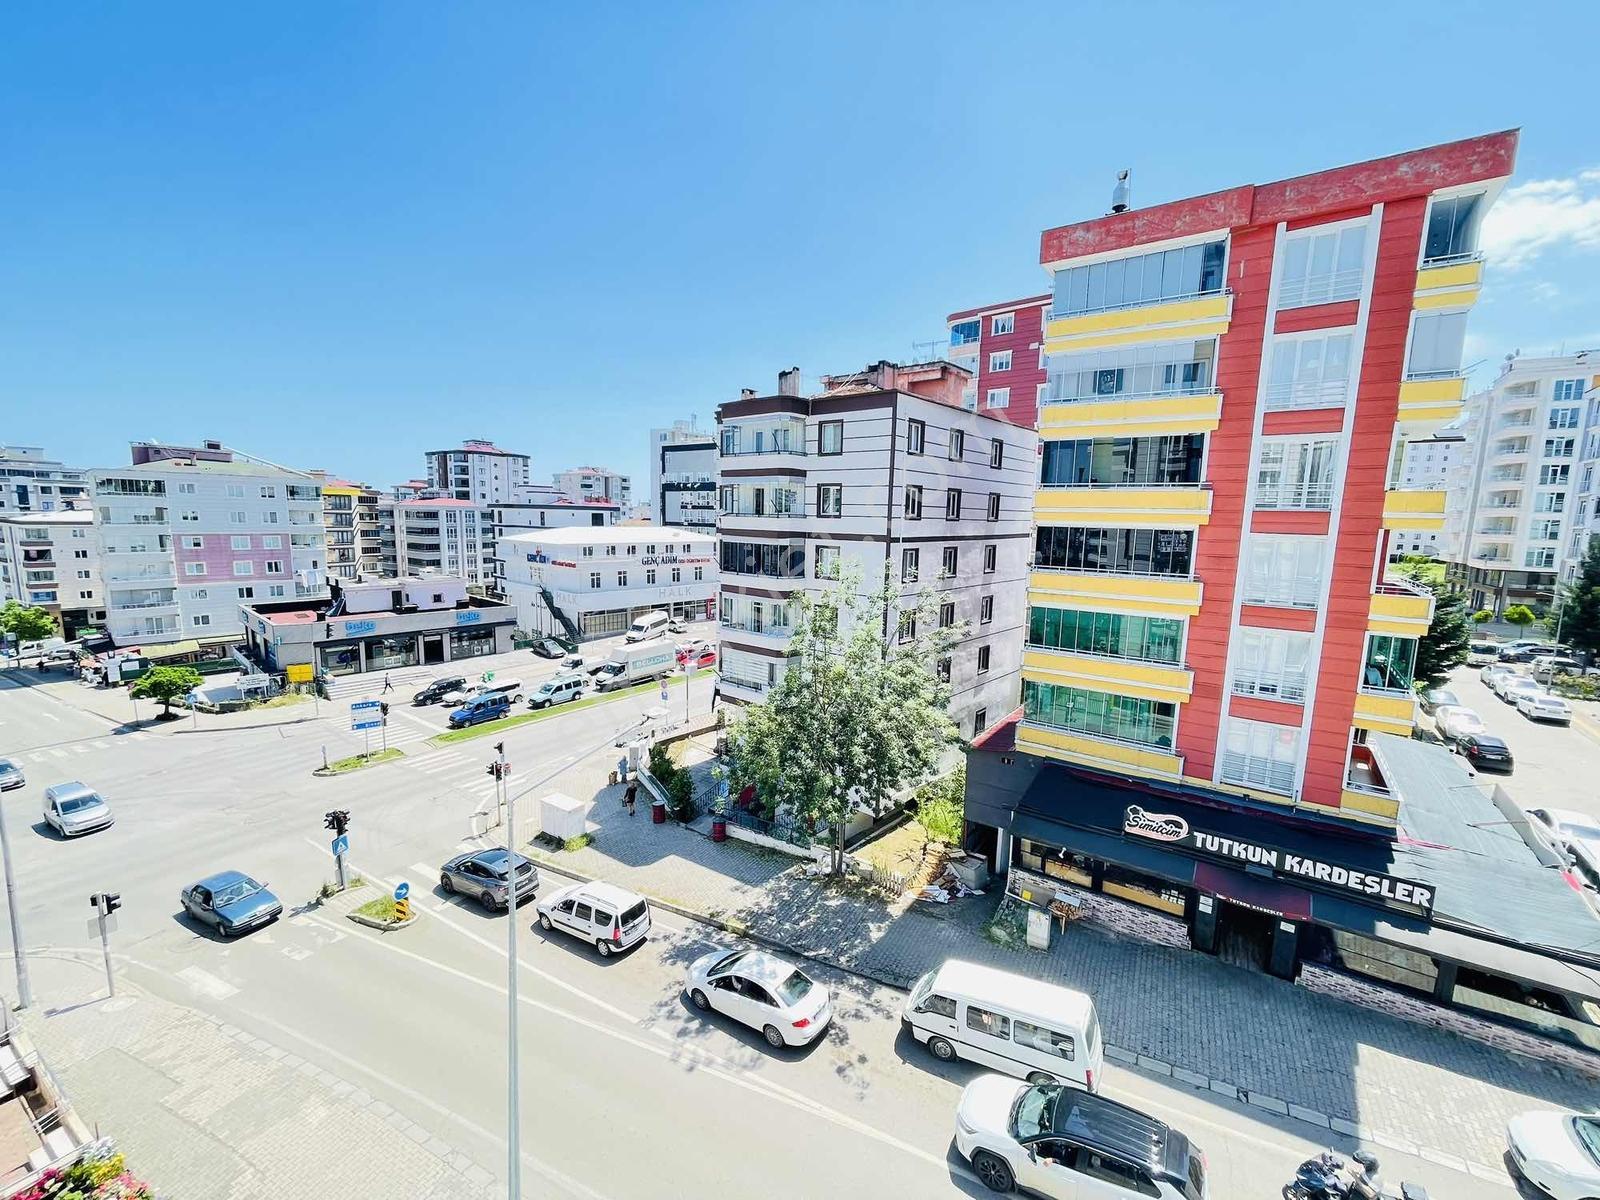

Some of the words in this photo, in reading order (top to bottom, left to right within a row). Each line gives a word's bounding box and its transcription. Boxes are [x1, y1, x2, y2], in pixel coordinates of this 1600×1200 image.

[658, 586, 692, 598] HALK
[455, 611, 481, 623] beko
[345, 619, 377, 633] beko
[1193, 831, 1278, 867] TUTKUN
[1284, 854, 1432, 907] KARDEŞLER
